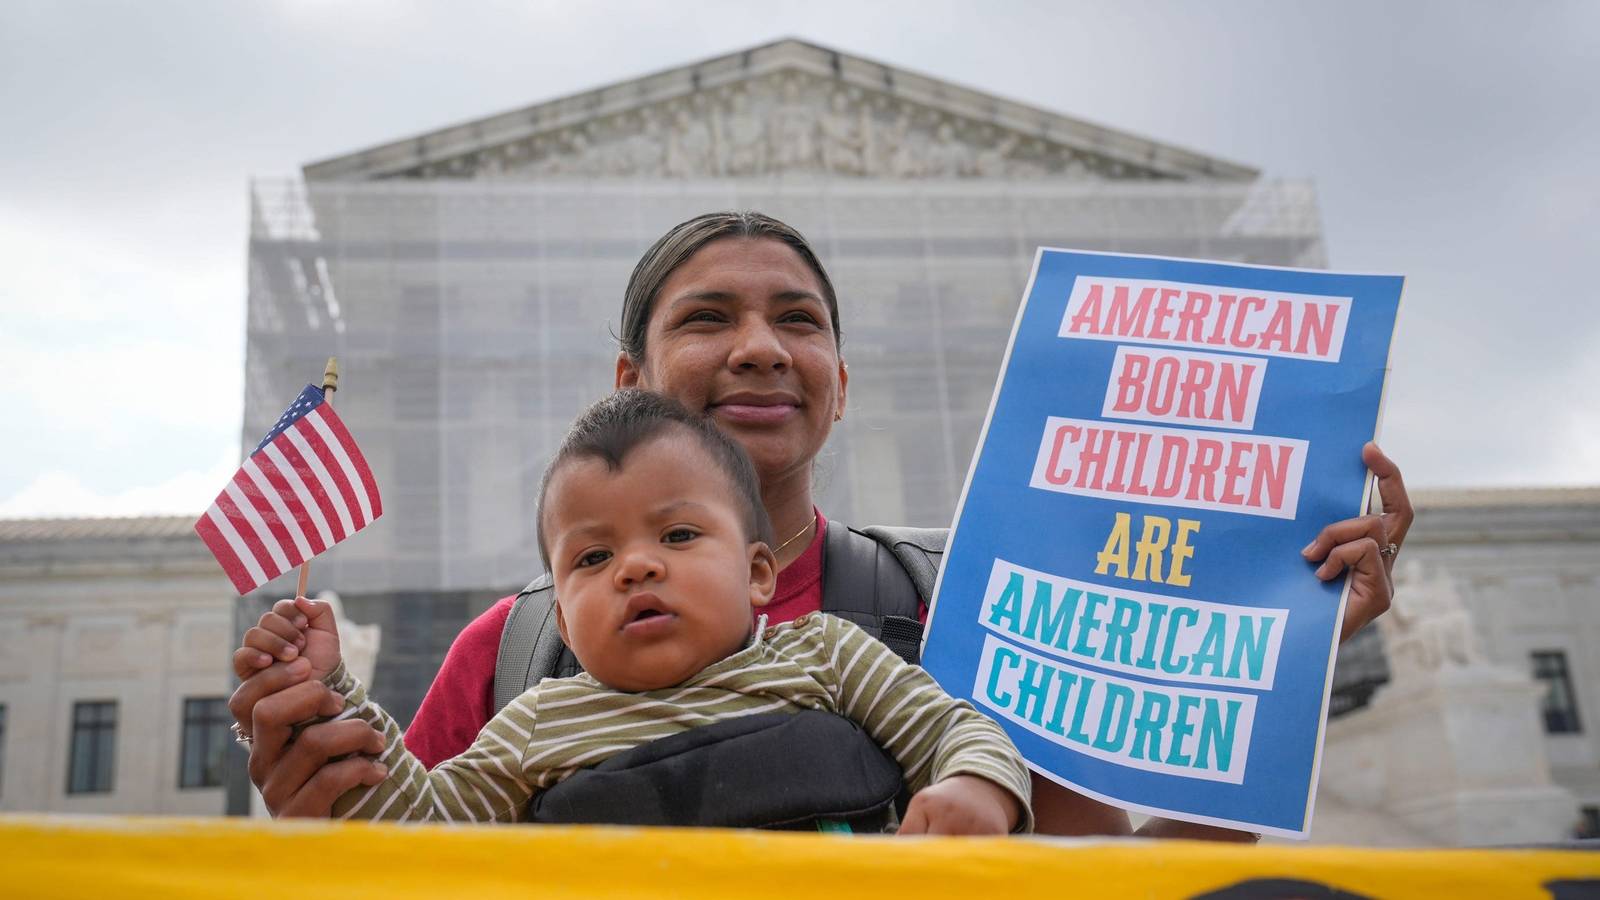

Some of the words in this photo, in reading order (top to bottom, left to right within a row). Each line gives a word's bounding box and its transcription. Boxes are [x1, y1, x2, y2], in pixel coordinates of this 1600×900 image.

[1069, 284, 1340, 356] AMERICAN
[1112, 354, 1255, 422] BORN
[1045, 426, 1294, 509] CHILDREN
[1095, 512, 1201, 587] ARE
[987, 572, 1275, 681] AMERICAN
[985, 646, 1242, 772] CHILDREN
